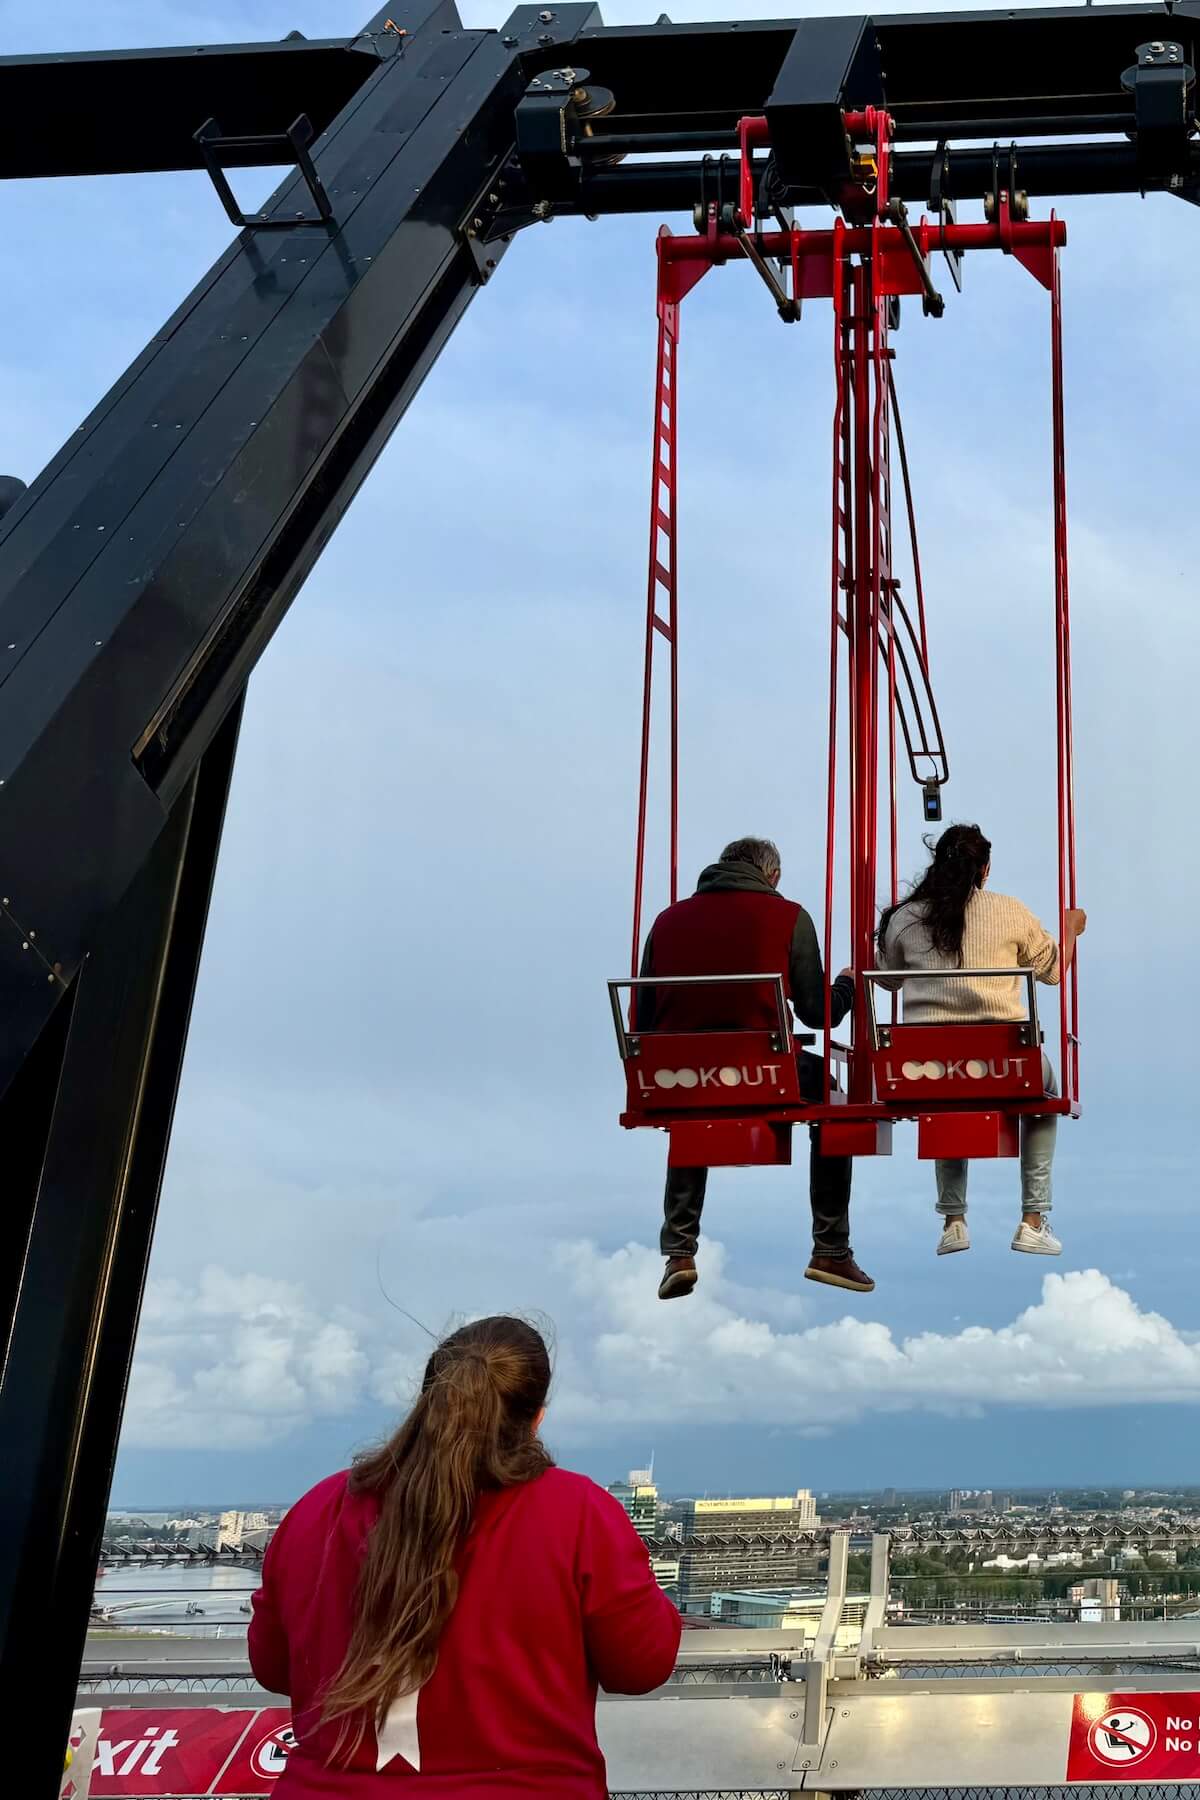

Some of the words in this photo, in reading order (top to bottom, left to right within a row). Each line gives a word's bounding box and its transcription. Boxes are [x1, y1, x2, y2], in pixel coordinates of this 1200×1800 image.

[637, 1065, 781, 1090] LOOKOUT
[885, 1058, 1028, 1081] LOOKOUT
[1166, 1716, 1192, 1731] No
[91, 1726, 180, 1776] xit
[1165, 1737, 1192, 1751] No
